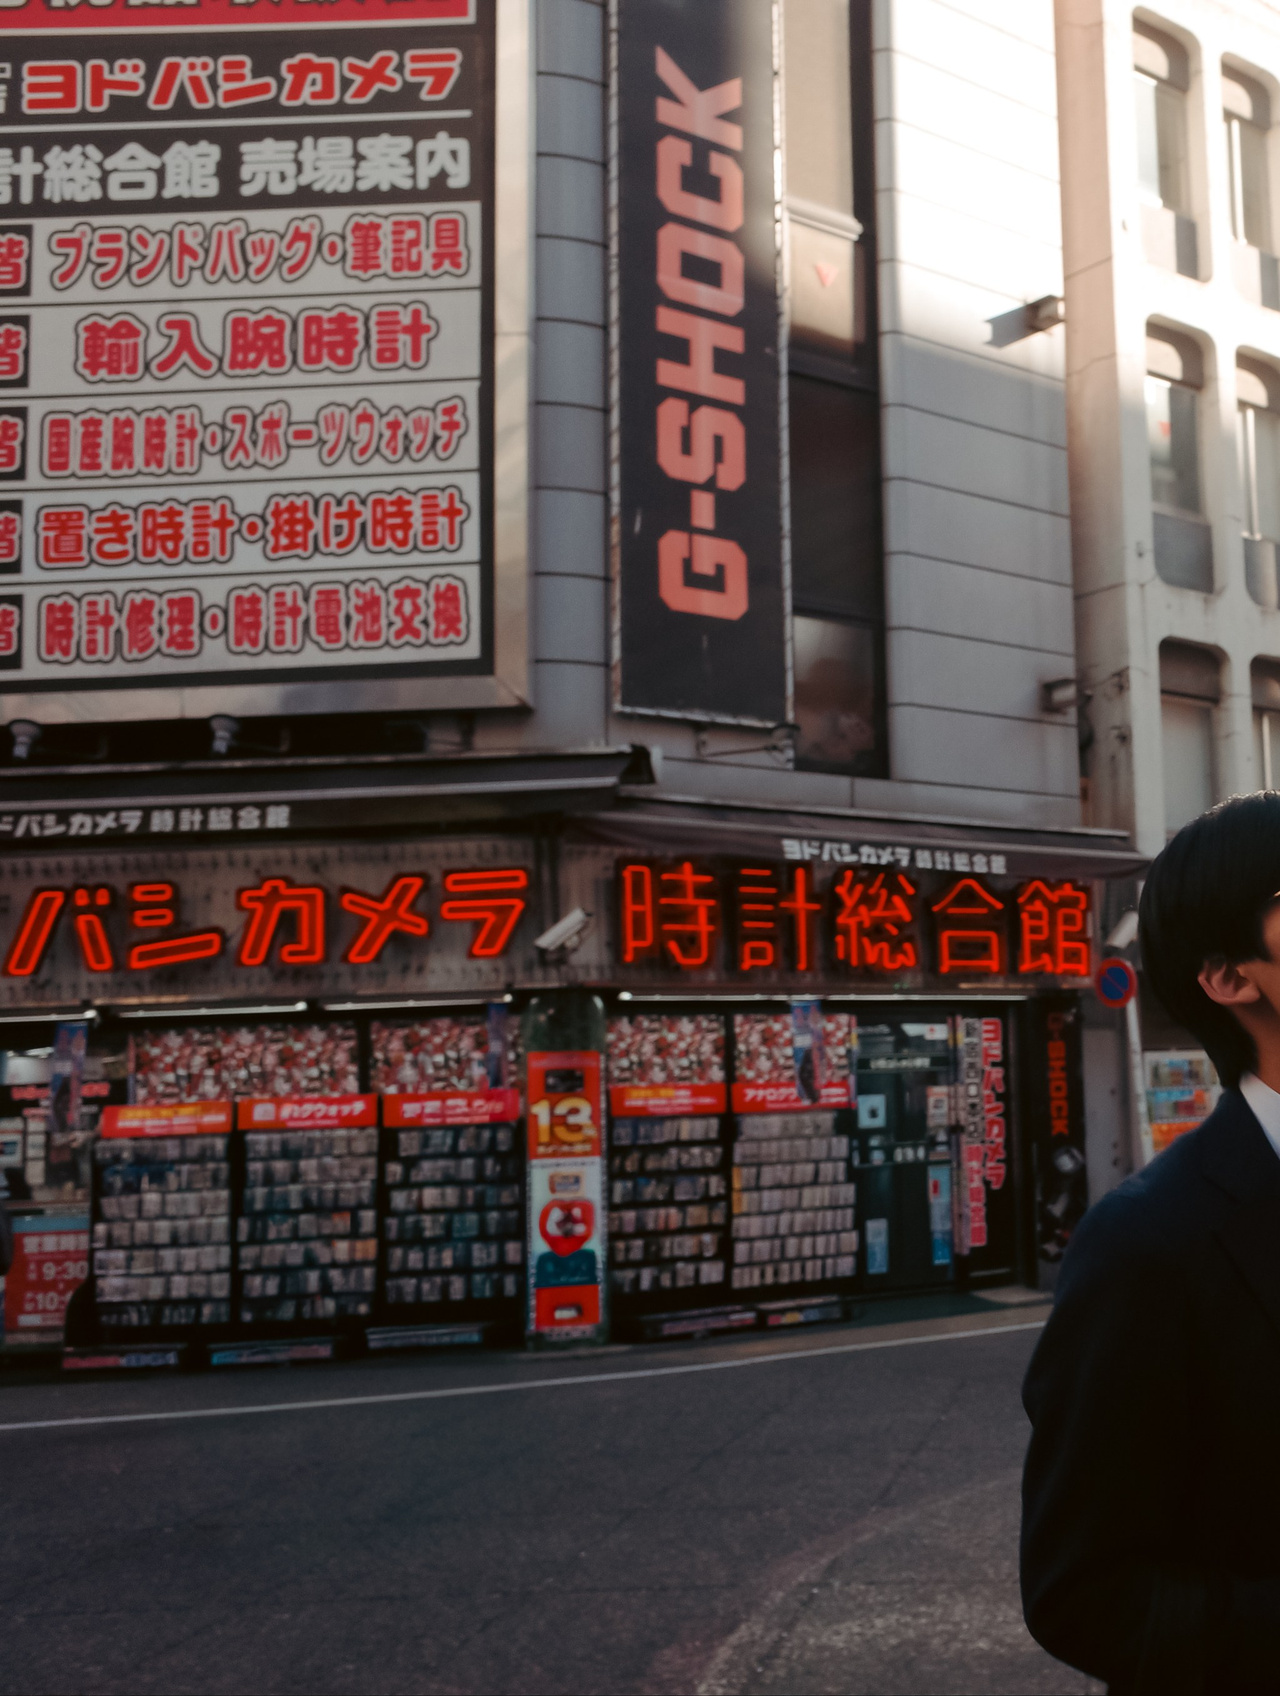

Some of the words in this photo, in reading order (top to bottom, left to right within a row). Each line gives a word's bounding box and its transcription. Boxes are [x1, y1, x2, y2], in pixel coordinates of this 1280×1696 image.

[21, 48, 463, 115] ヨドバシカメラ
[239, 131, 471, 197] 売場案内
[50, 211, 469, 290] ブランドバッグ・筆記具
[76, 301, 439, 383] 輸入腕時計
[655, 44, 749, 622] G-SHOCK
[36, 485, 470, 570] 置き時計・掛け時計
[38, 574, 469, 665] 時計修理・時計電池交換
[781, 838, 911, 867] ヨドバシカメラ
[5, 868, 530, 976] バシカメラ
[621, 861, 1093, 977] 時計総合館
